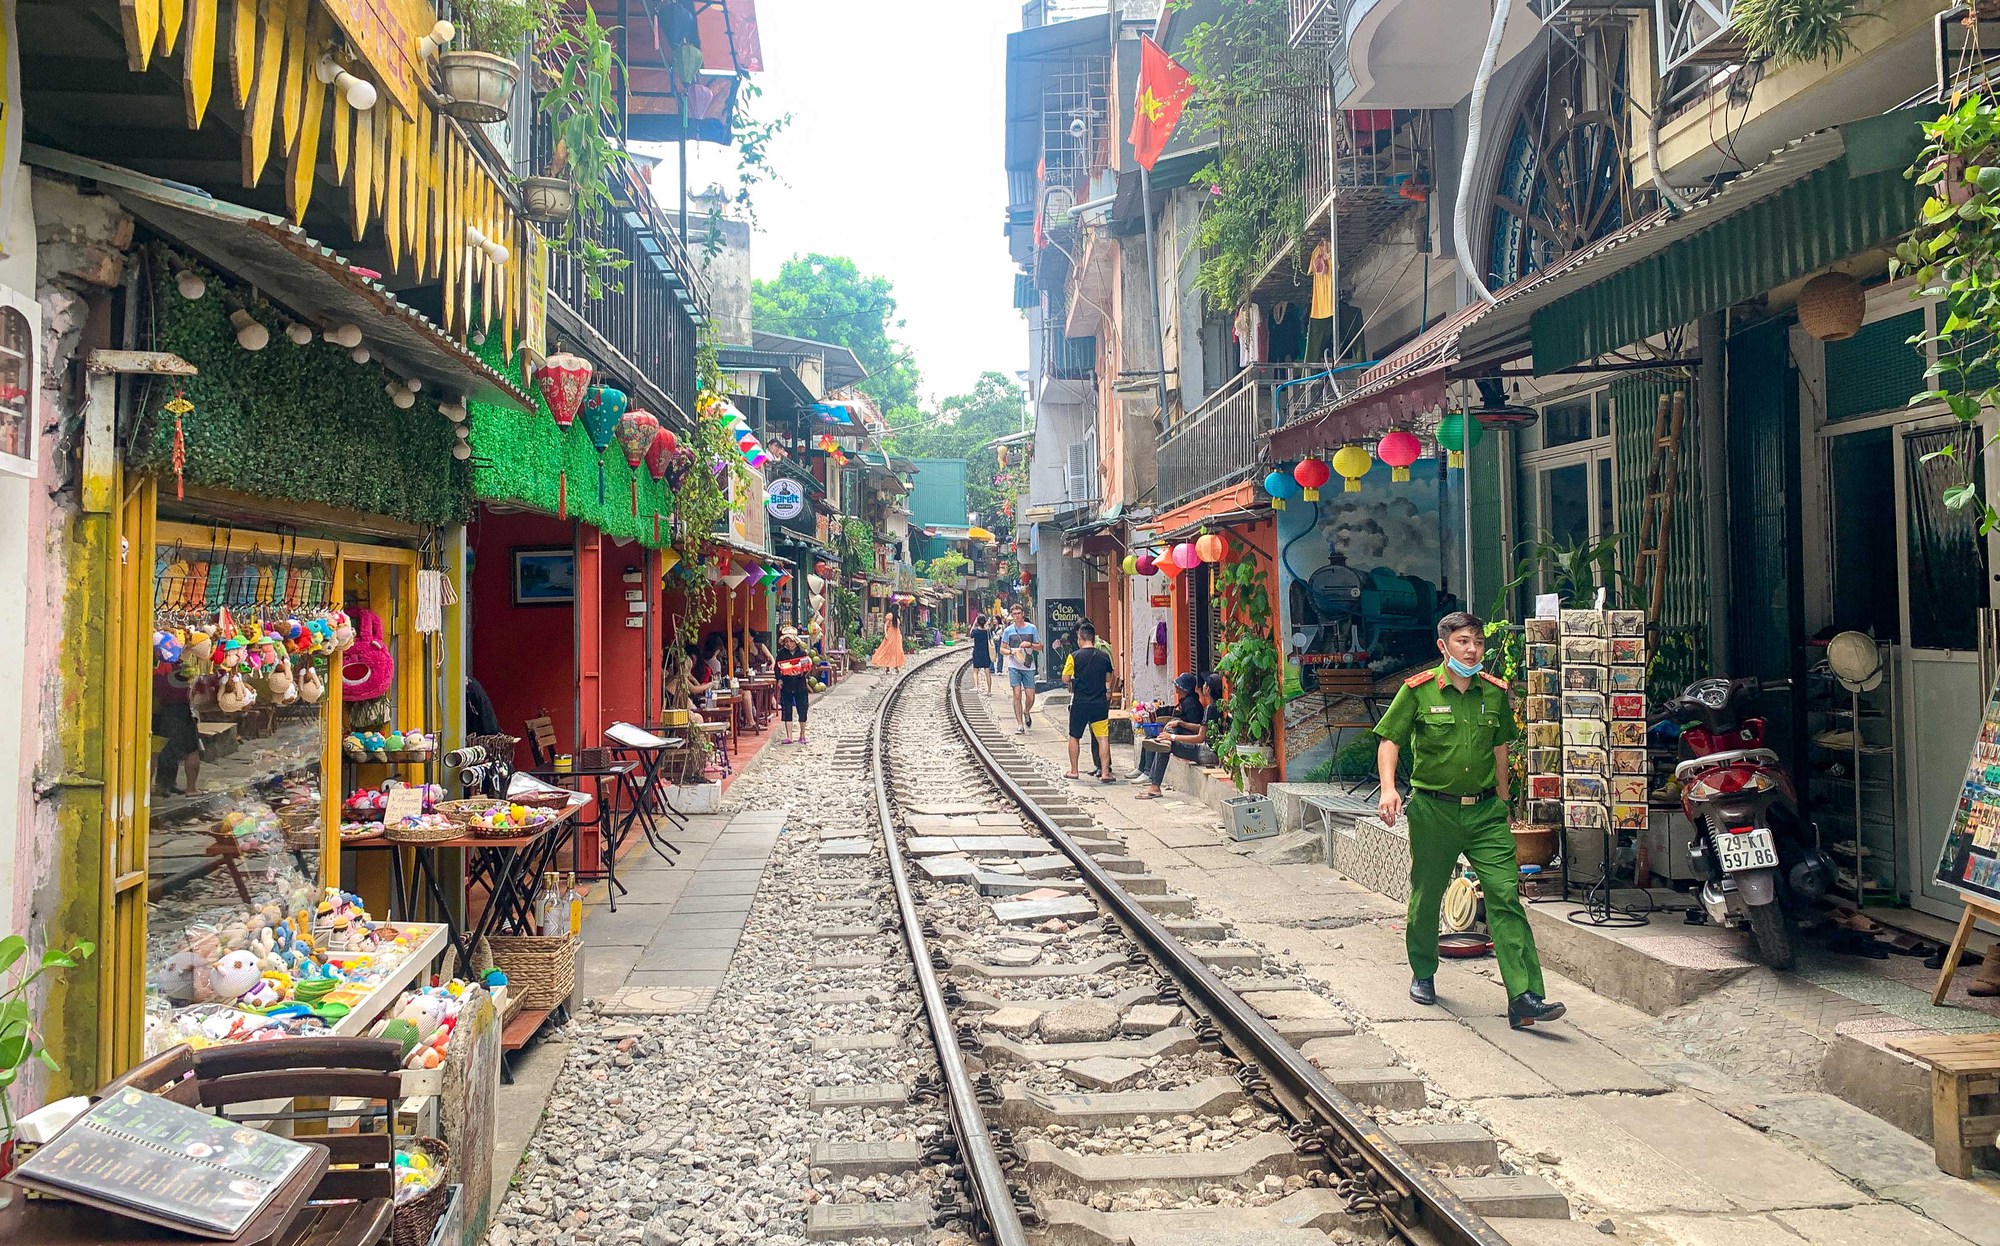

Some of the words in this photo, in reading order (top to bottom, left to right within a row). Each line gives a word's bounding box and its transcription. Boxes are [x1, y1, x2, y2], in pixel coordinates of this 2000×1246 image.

[771, 493, 799, 504] Barett
[1057, 603, 1074, 614] Ice
[1052, 609, 1079, 621] Cream
[1725, 833, 1765, 852] 29-K1
[1723, 848, 1774, 869] 597.86
